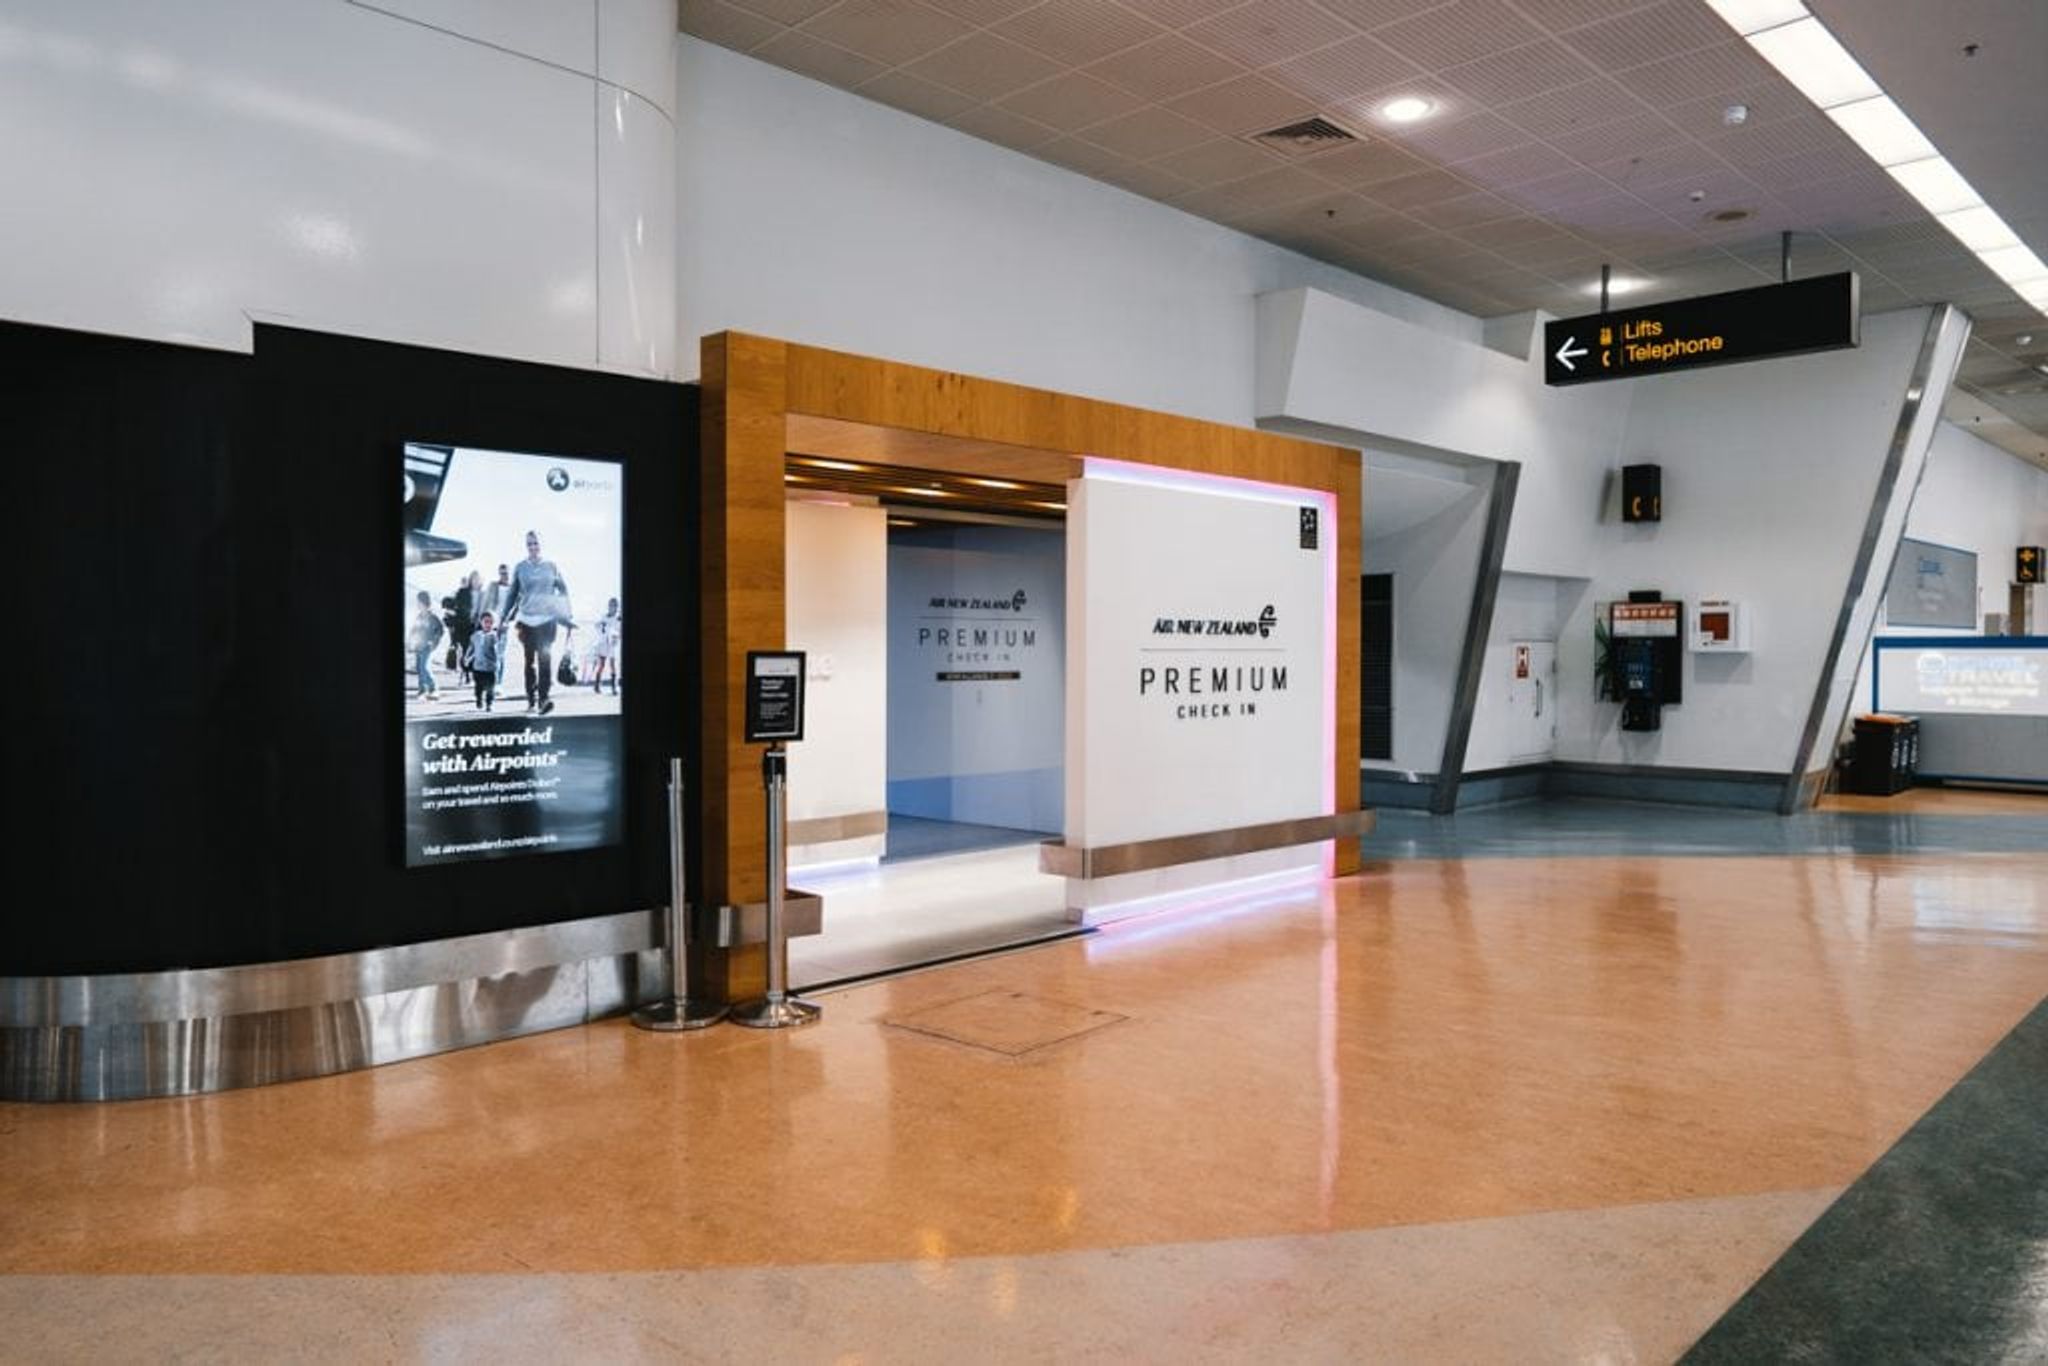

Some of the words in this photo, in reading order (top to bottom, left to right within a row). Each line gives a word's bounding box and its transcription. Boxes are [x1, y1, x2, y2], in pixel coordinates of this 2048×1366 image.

[1625, 320, 1663, 339] Lifts
[1626, 336, 1724, 362] Telephone
[946, 598, 968, 609] NEW
[970, 598, 1011, 610] ZEALAND
[1153, 618, 1174, 633] AIR
[1177, 619, 1205, 635] NEW
[1206, 620, 1257, 636] ZEALAND
[919, 627, 1036, 647] PREMIUM
[948, 652, 989, 663] CHECK
[1140, 666, 1287, 695] PREMIUM
[1177, 704, 1231, 719] CHECK
[1240, 702, 1256, 716] IN
[422, 733, 456, 750] Get
[459, 726, 552, 749] rewarded
[422, 753, 467, 774] with
[444, 784, 461, 795] and
